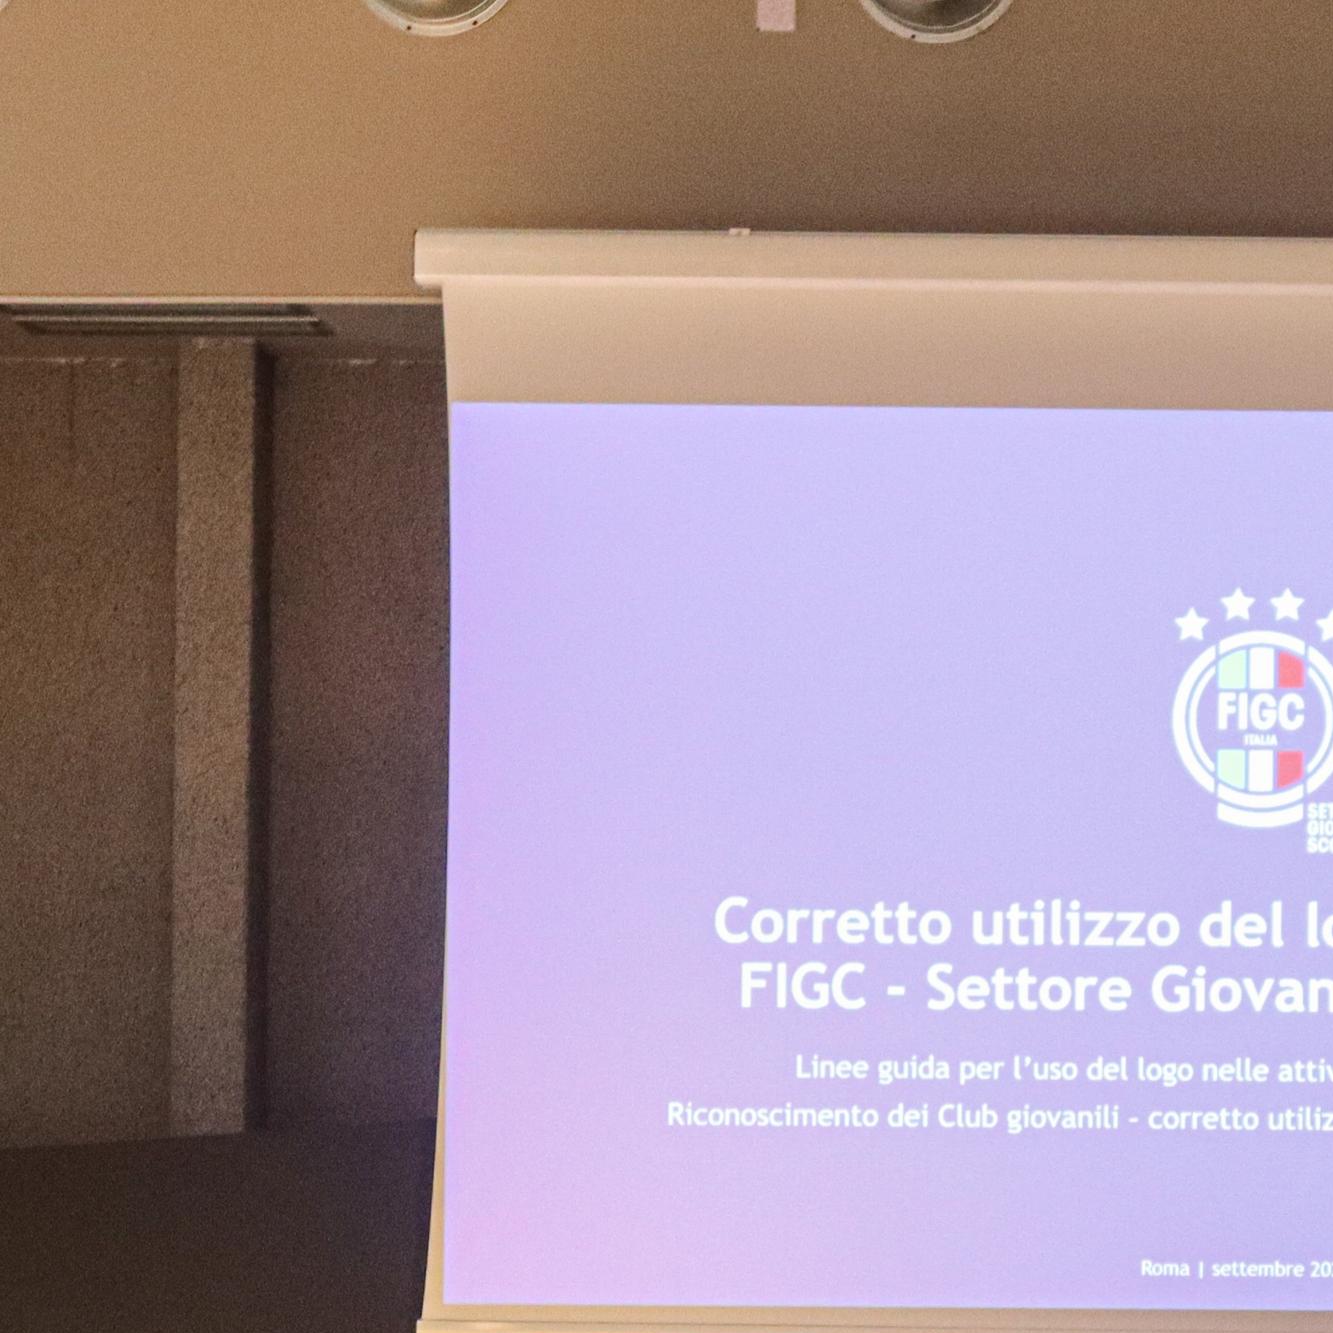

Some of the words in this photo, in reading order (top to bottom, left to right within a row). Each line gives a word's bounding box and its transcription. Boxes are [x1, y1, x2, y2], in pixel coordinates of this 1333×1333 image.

[1217, 692, 1305, 731] FIGC
[1243, 734, 1278, 746] ITALIA
[714, 895, 953, 945] Corretto
[972, 898, 1181, 947] utilizzo
[1198, 899, 1285, 949] del
[740, 961, 867, 1010] FIGC
[926, 962, 1133, 1012] Settore
[795, 1053, 870, 1079] Linee
[877, 1053, 951, 1086] guida
[959, 1060, 1006, 1086] per
[1085, 1055, 1129, 1082] del
[1137, 1055, 1195, 1088] logo
[1201, 1057, 1270, 1083] nelle
[667, 1100, 880, 1128] Riconoscimento
[887, 1102, 929, 1128] dei
[937, 1102, 999, 1129] Club
[1006, 1103, 1120, 1135] giovanili
[1147, 1107, 1260, 1131] corretto
[1140, 1258, 1191, 1277] Roma
[1211, 1259, 1306, 1278] settembre
